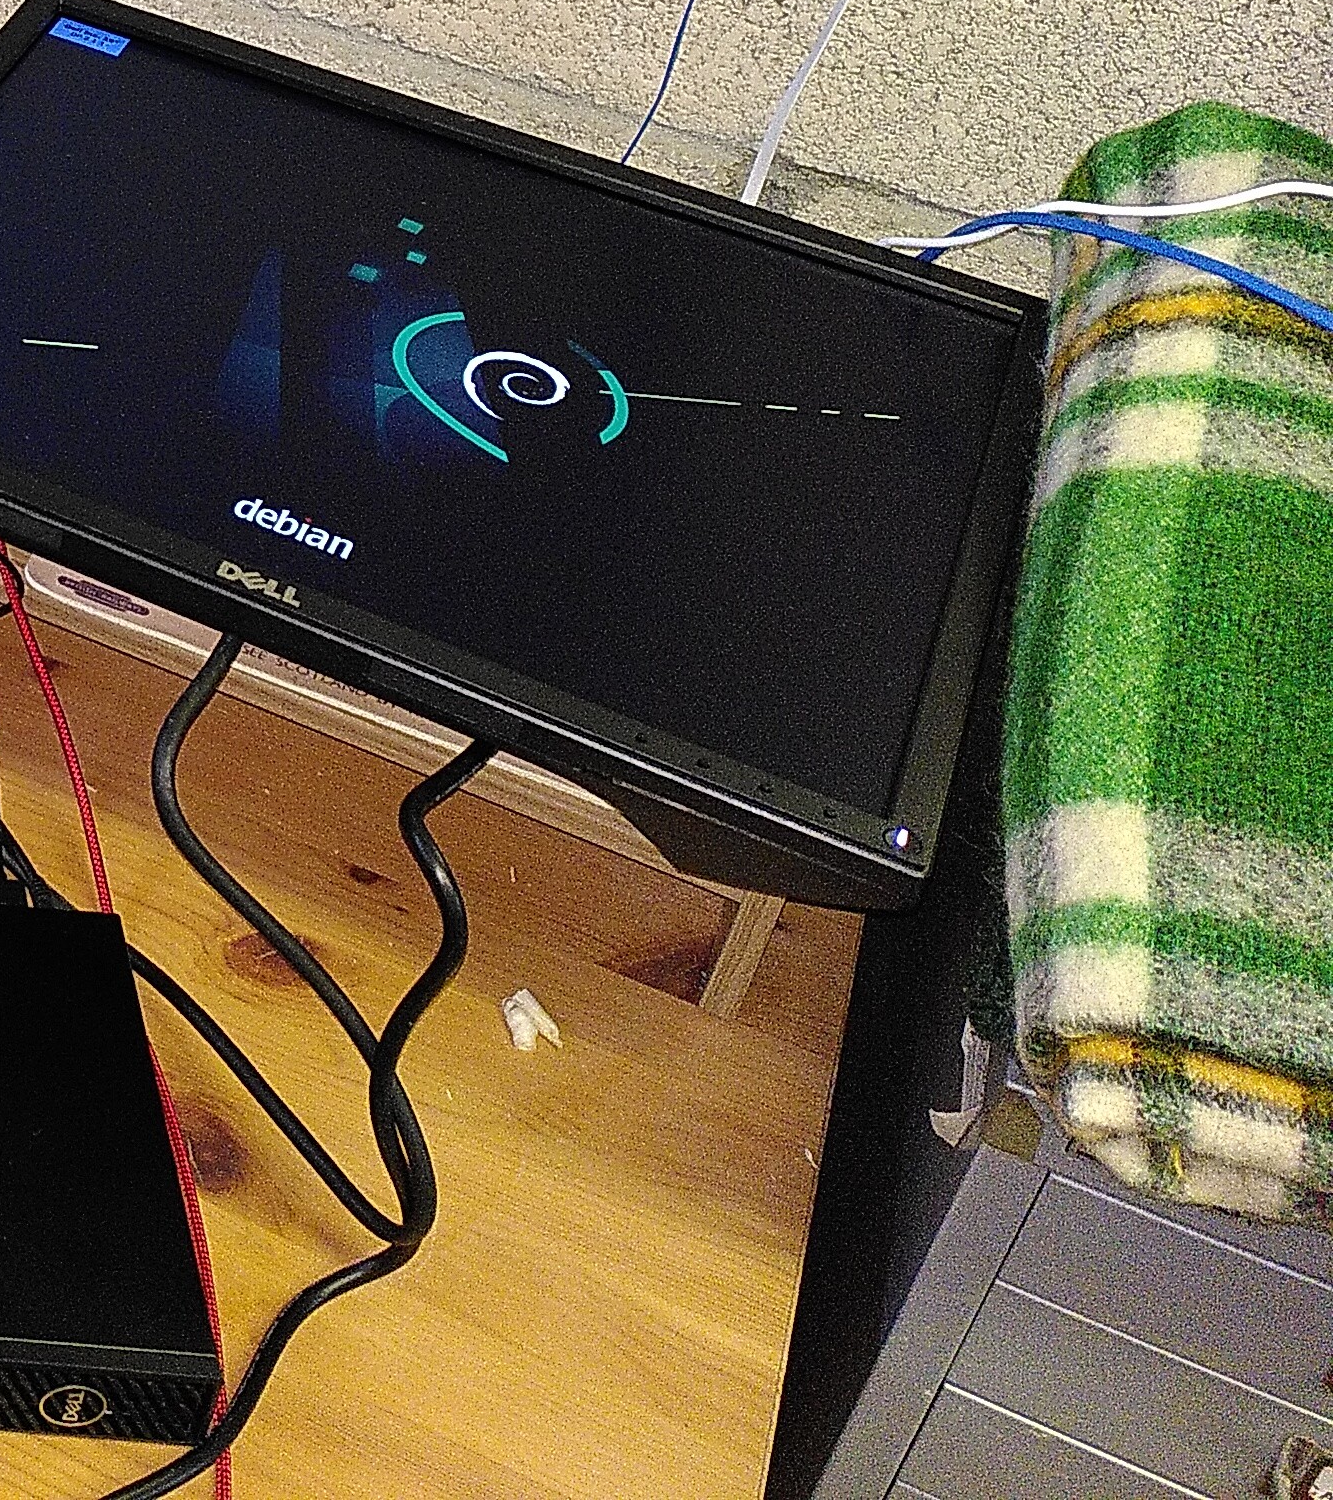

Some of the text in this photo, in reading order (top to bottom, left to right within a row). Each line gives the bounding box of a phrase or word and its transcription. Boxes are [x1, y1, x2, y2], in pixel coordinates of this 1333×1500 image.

[234, 498, 354, 560] debian
[216, 560, 301, 609] DELL
[241, 643, 273, 662] SEE
[61, 1390, 85, 1423] DELL
